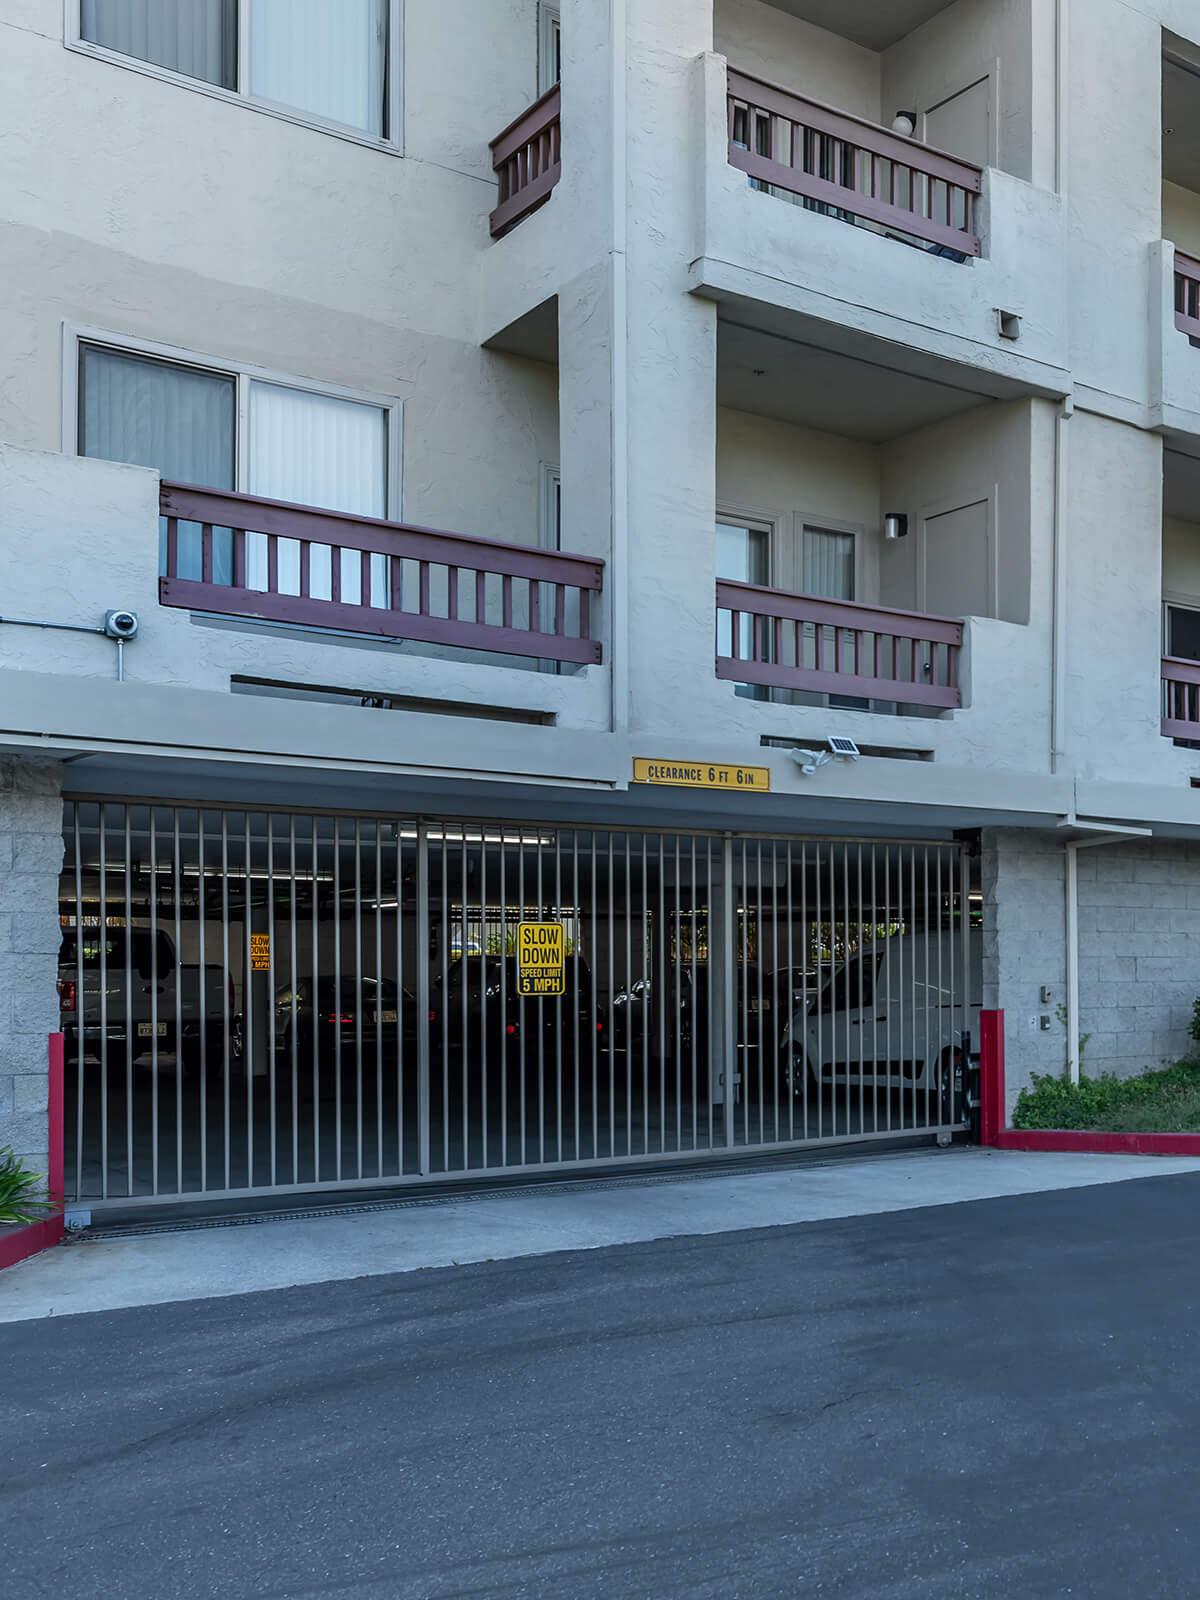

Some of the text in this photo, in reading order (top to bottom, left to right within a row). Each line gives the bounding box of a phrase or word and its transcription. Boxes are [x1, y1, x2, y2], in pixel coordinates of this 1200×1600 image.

[648, 765, 702, 781] CLEARANCE
[708, 767, 715, 782] 6
[719, 772, 728, 783] FT
[250, 937, 269, 946] SLOW
[524, 928, 558, 944] SLOW
[523, 948, 559, 963] DOWN
[520, 968, 561, 977] SPEED LIMIT
[523, 978, 560, 992] 5 MPH
